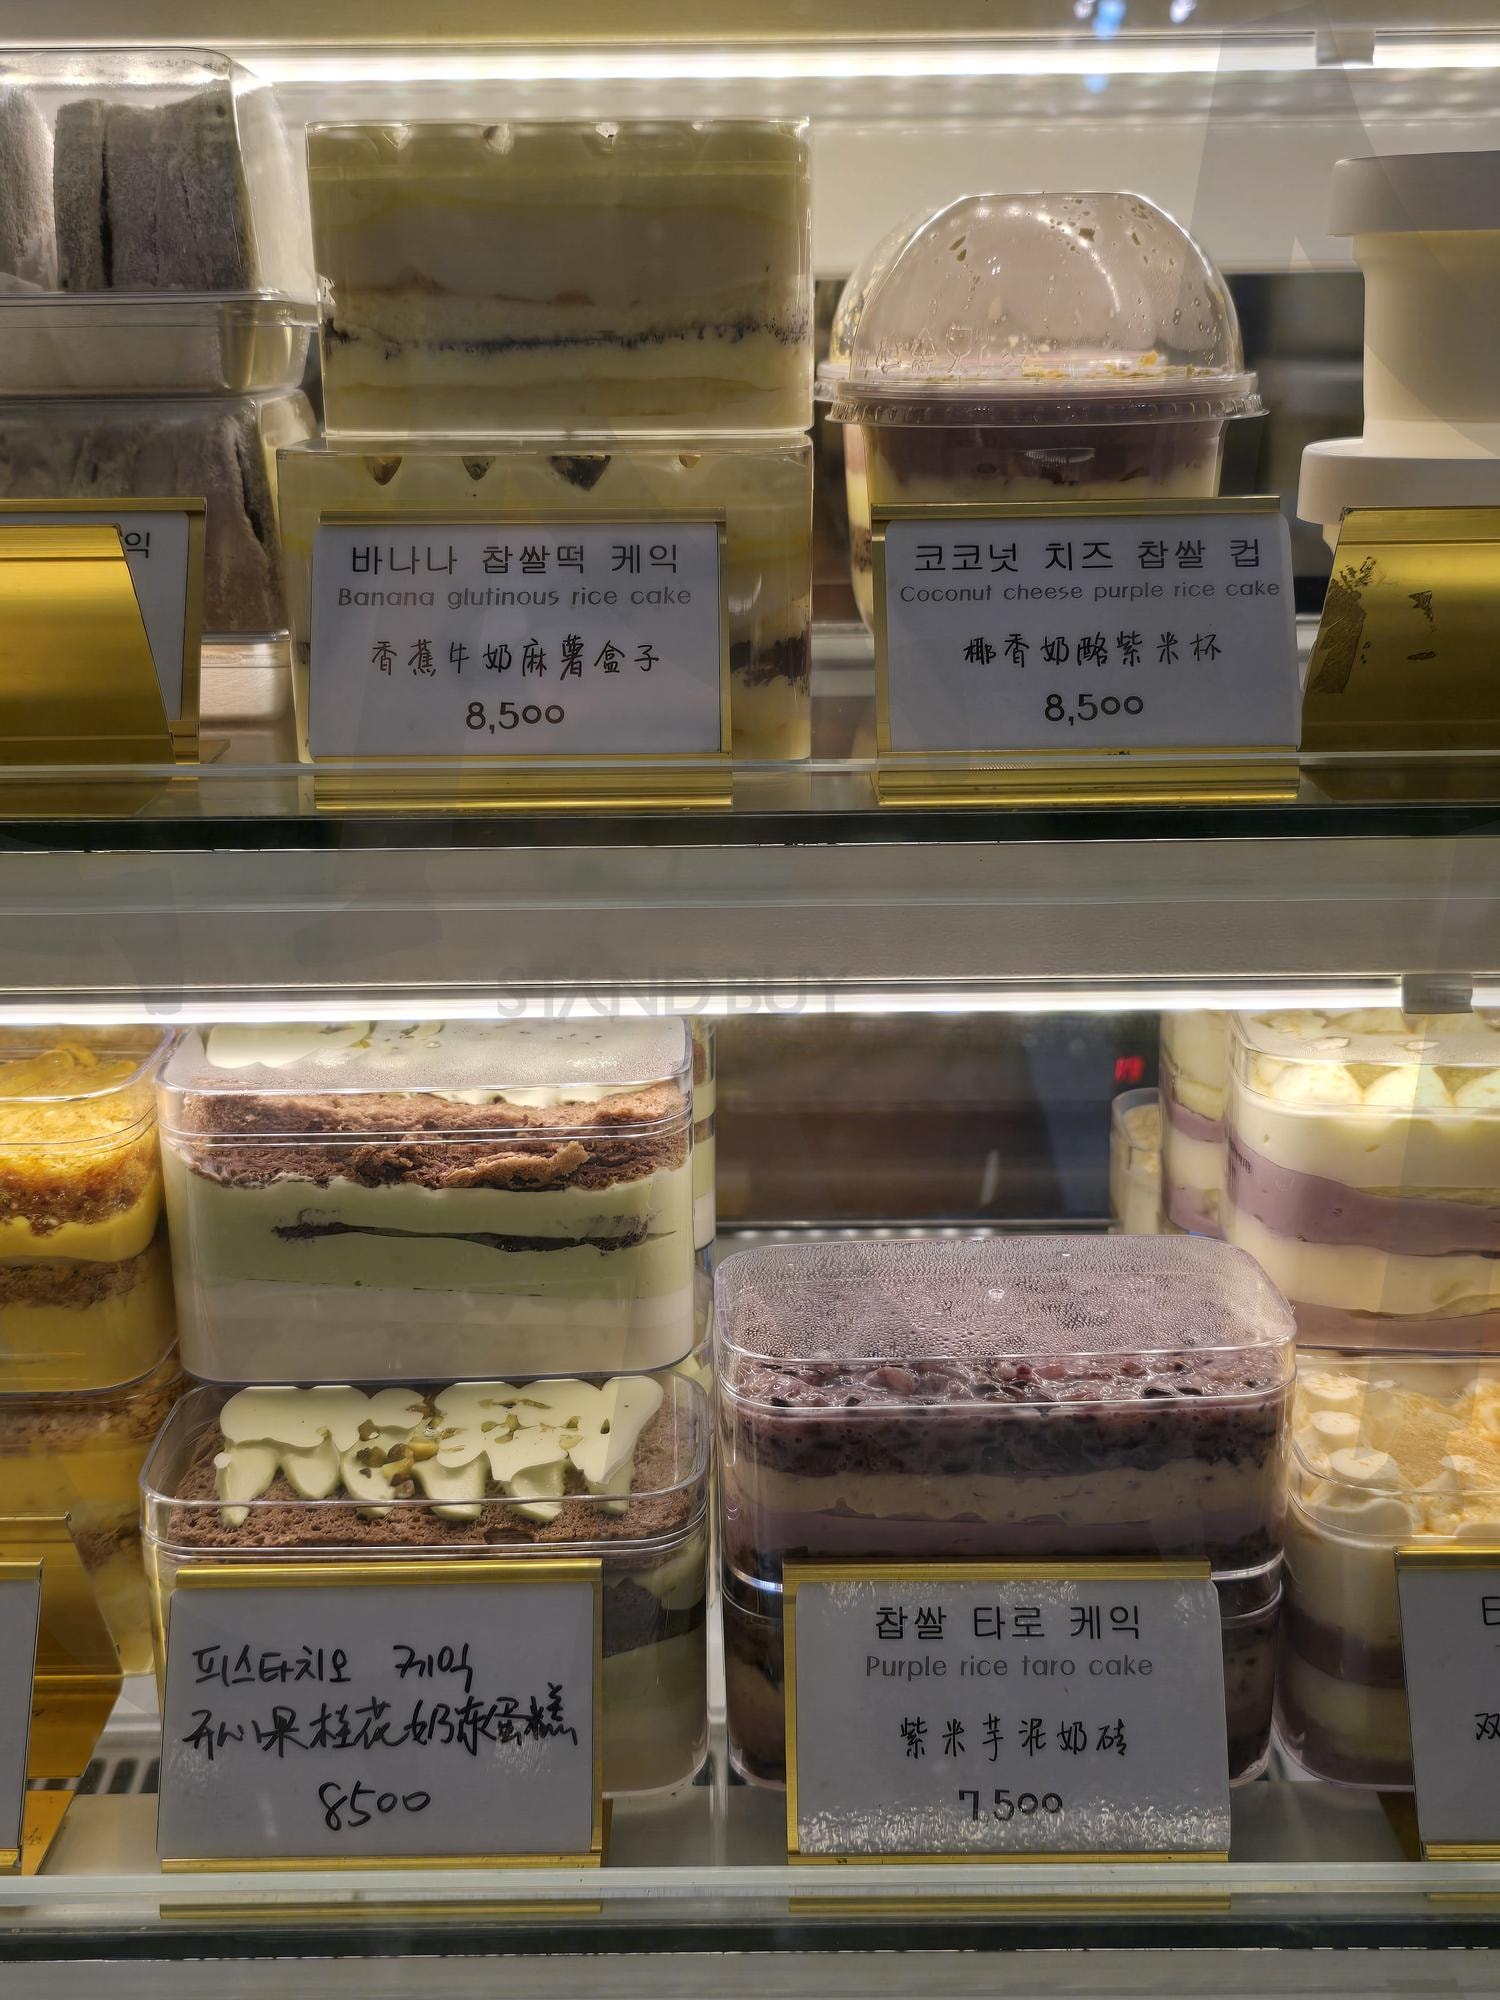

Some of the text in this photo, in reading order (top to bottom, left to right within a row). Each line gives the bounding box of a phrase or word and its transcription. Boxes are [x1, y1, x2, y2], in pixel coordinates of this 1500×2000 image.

[124, 532, 151, 559] 익
[352, 544, 679, 575] 바나나 찹쌀떡 케익
[914, 538, 1261, 573] 코코넛 치즈 찹쌀 컵
[338, 585, 692, 609] Banana glutinous rice cake
[899, 579, 1281, 603] Coconut cheese purple rice cake
[371, 633, 660, 681] 香蕉牛奶麻薯盒子
[962, 630, 1222, 669] 椰香奶酪紫米杯
[465, 701, 566, 734] 8,500
[1044, 693, 1144, 726] 8,500
[875, 1605, 1140, 1641] 찹쌀 타로 케익
[192, 1643, 352, 1687] 피스타치오
[866, 1654, 1154, 1682] Purple rice taro cake
[900, 1712, 1128, 1762] 紫米芋泥奶砖
[318, 1780, 432, 1832] 8500
